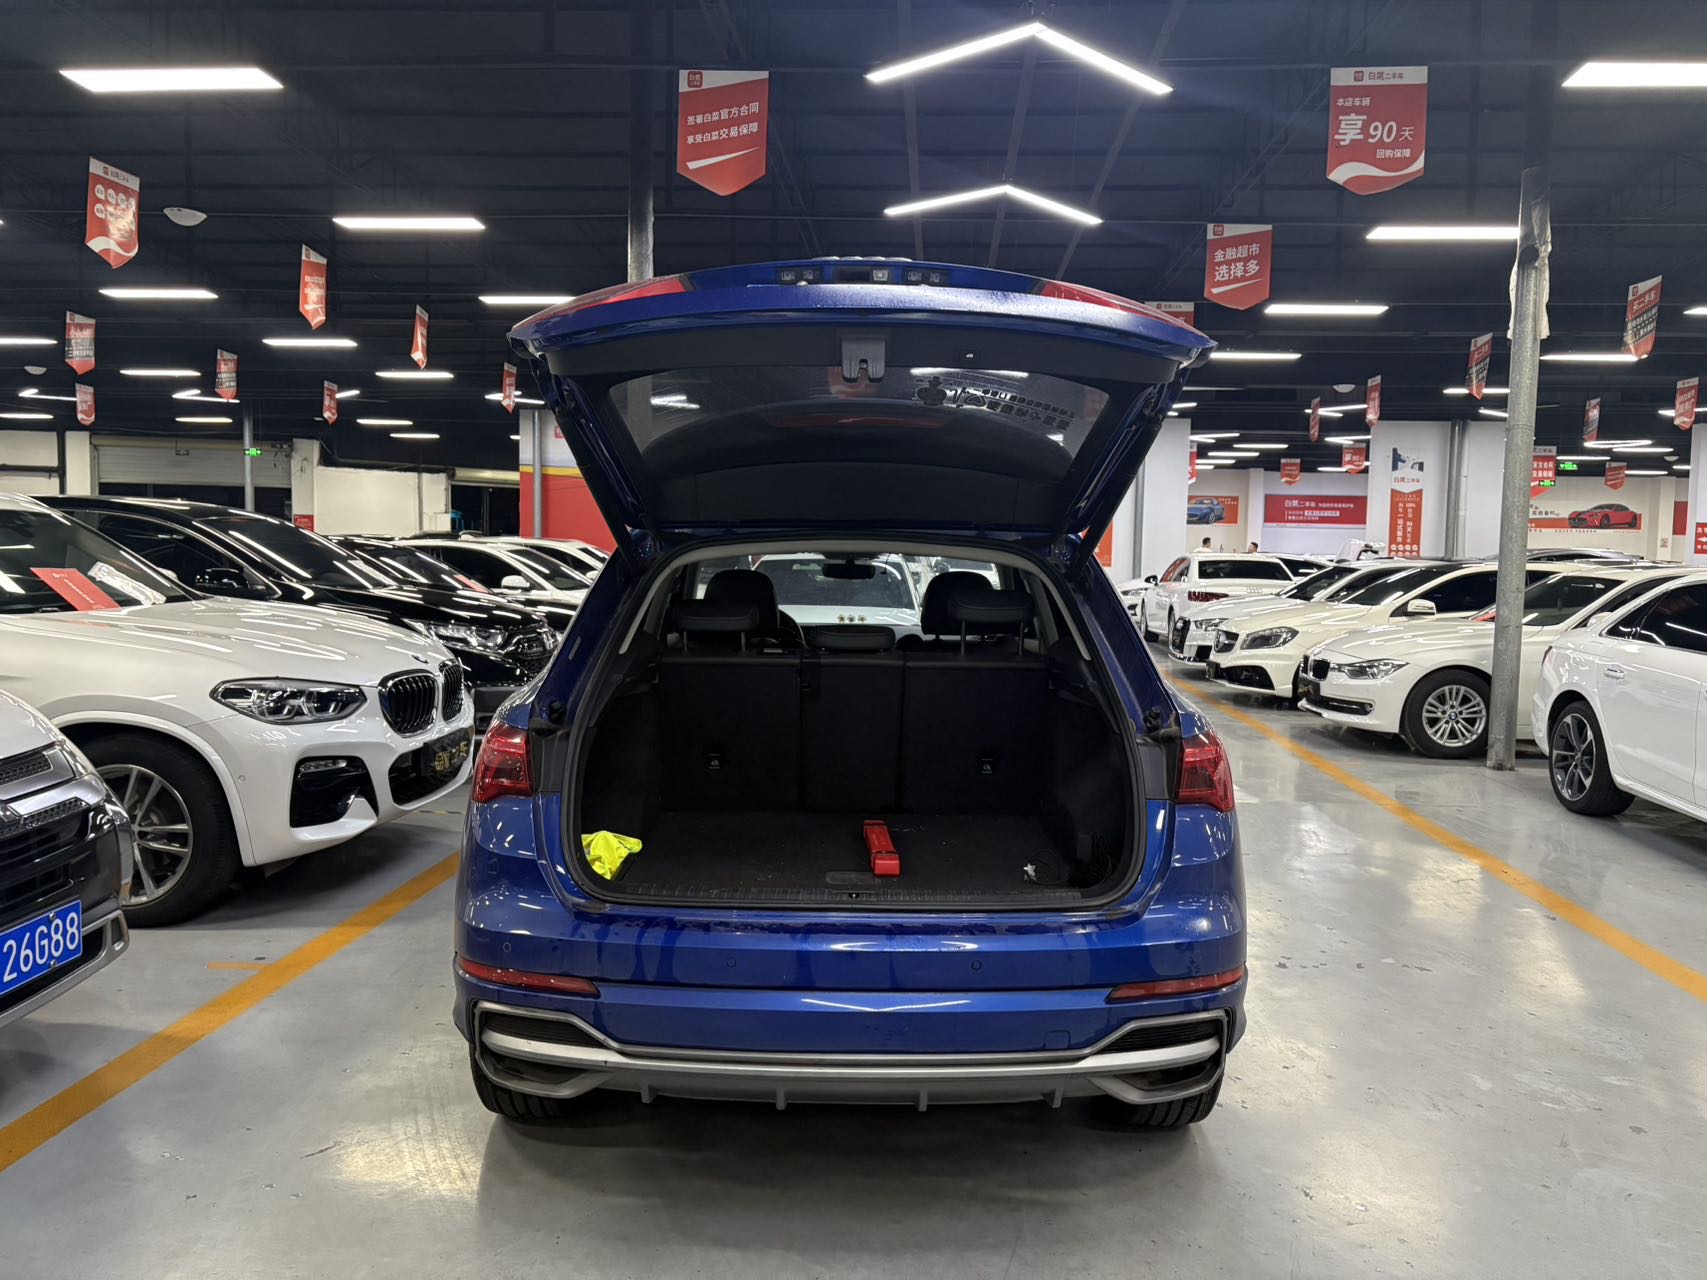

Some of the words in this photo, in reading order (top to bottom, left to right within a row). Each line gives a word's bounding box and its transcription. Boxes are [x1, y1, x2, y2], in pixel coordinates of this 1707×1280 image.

[1336, 97, 1371, 106] 本店车辆
[1376, 149, 1411, 159] 回购保障
[1214, 243, 1260, 262] 金融超市
[1214, 259, 1260, 282] 选择多
[3, 911, 79, 983] 26G88
